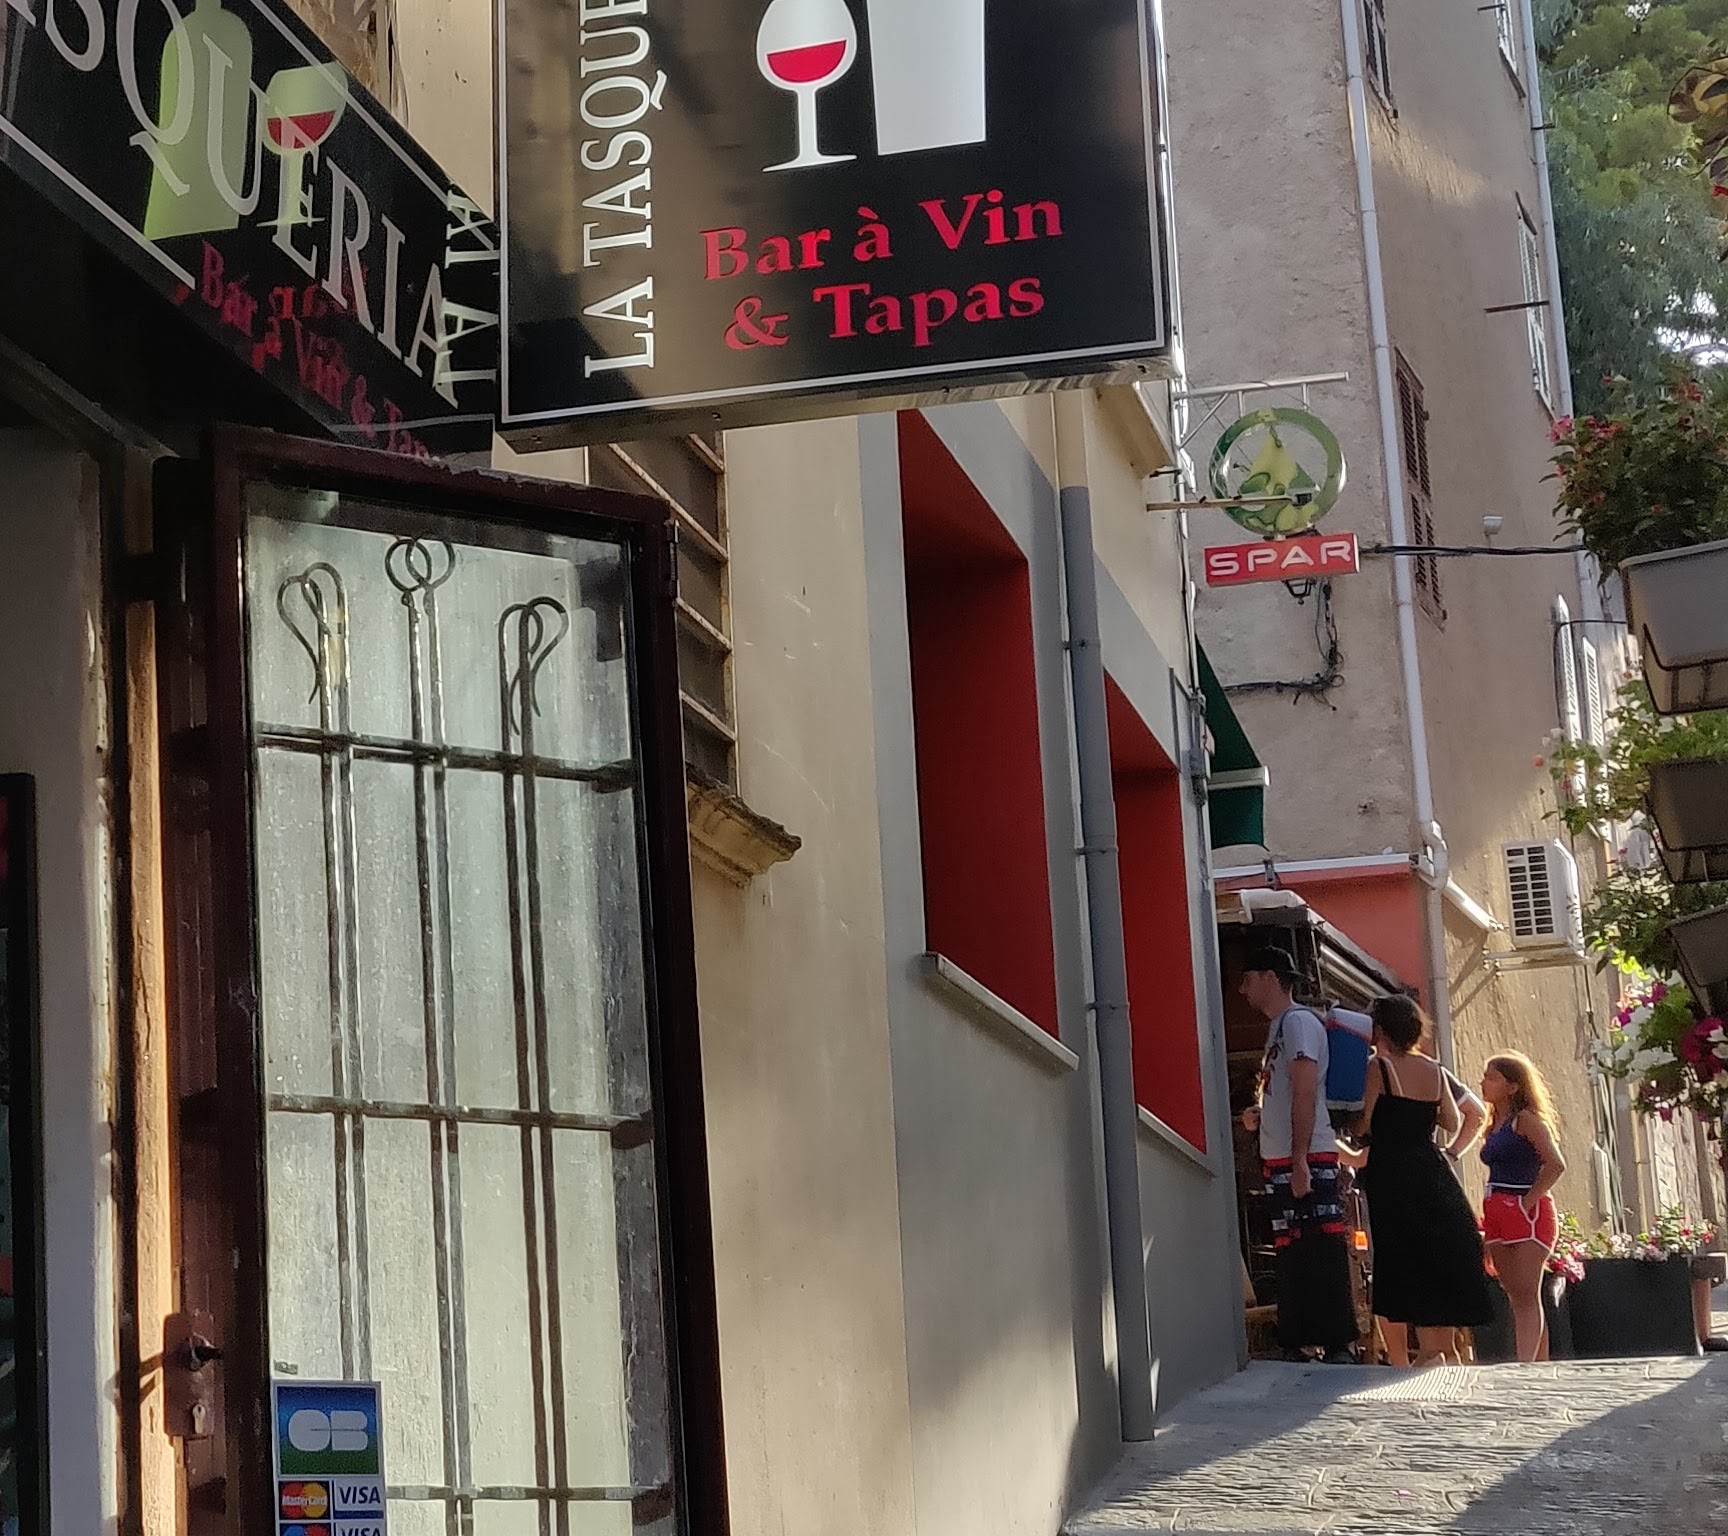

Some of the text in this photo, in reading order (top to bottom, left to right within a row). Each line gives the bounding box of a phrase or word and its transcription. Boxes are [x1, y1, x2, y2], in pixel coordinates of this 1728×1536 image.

[698, 189, 1064, 281] Bar à Vin
[582, 275, 655, 379] LA
[723, 277, 1045, 350] & Tapas
[1209, 540, 1351, 576] SPAR
[339, 1486, 381, 1504] VISA
